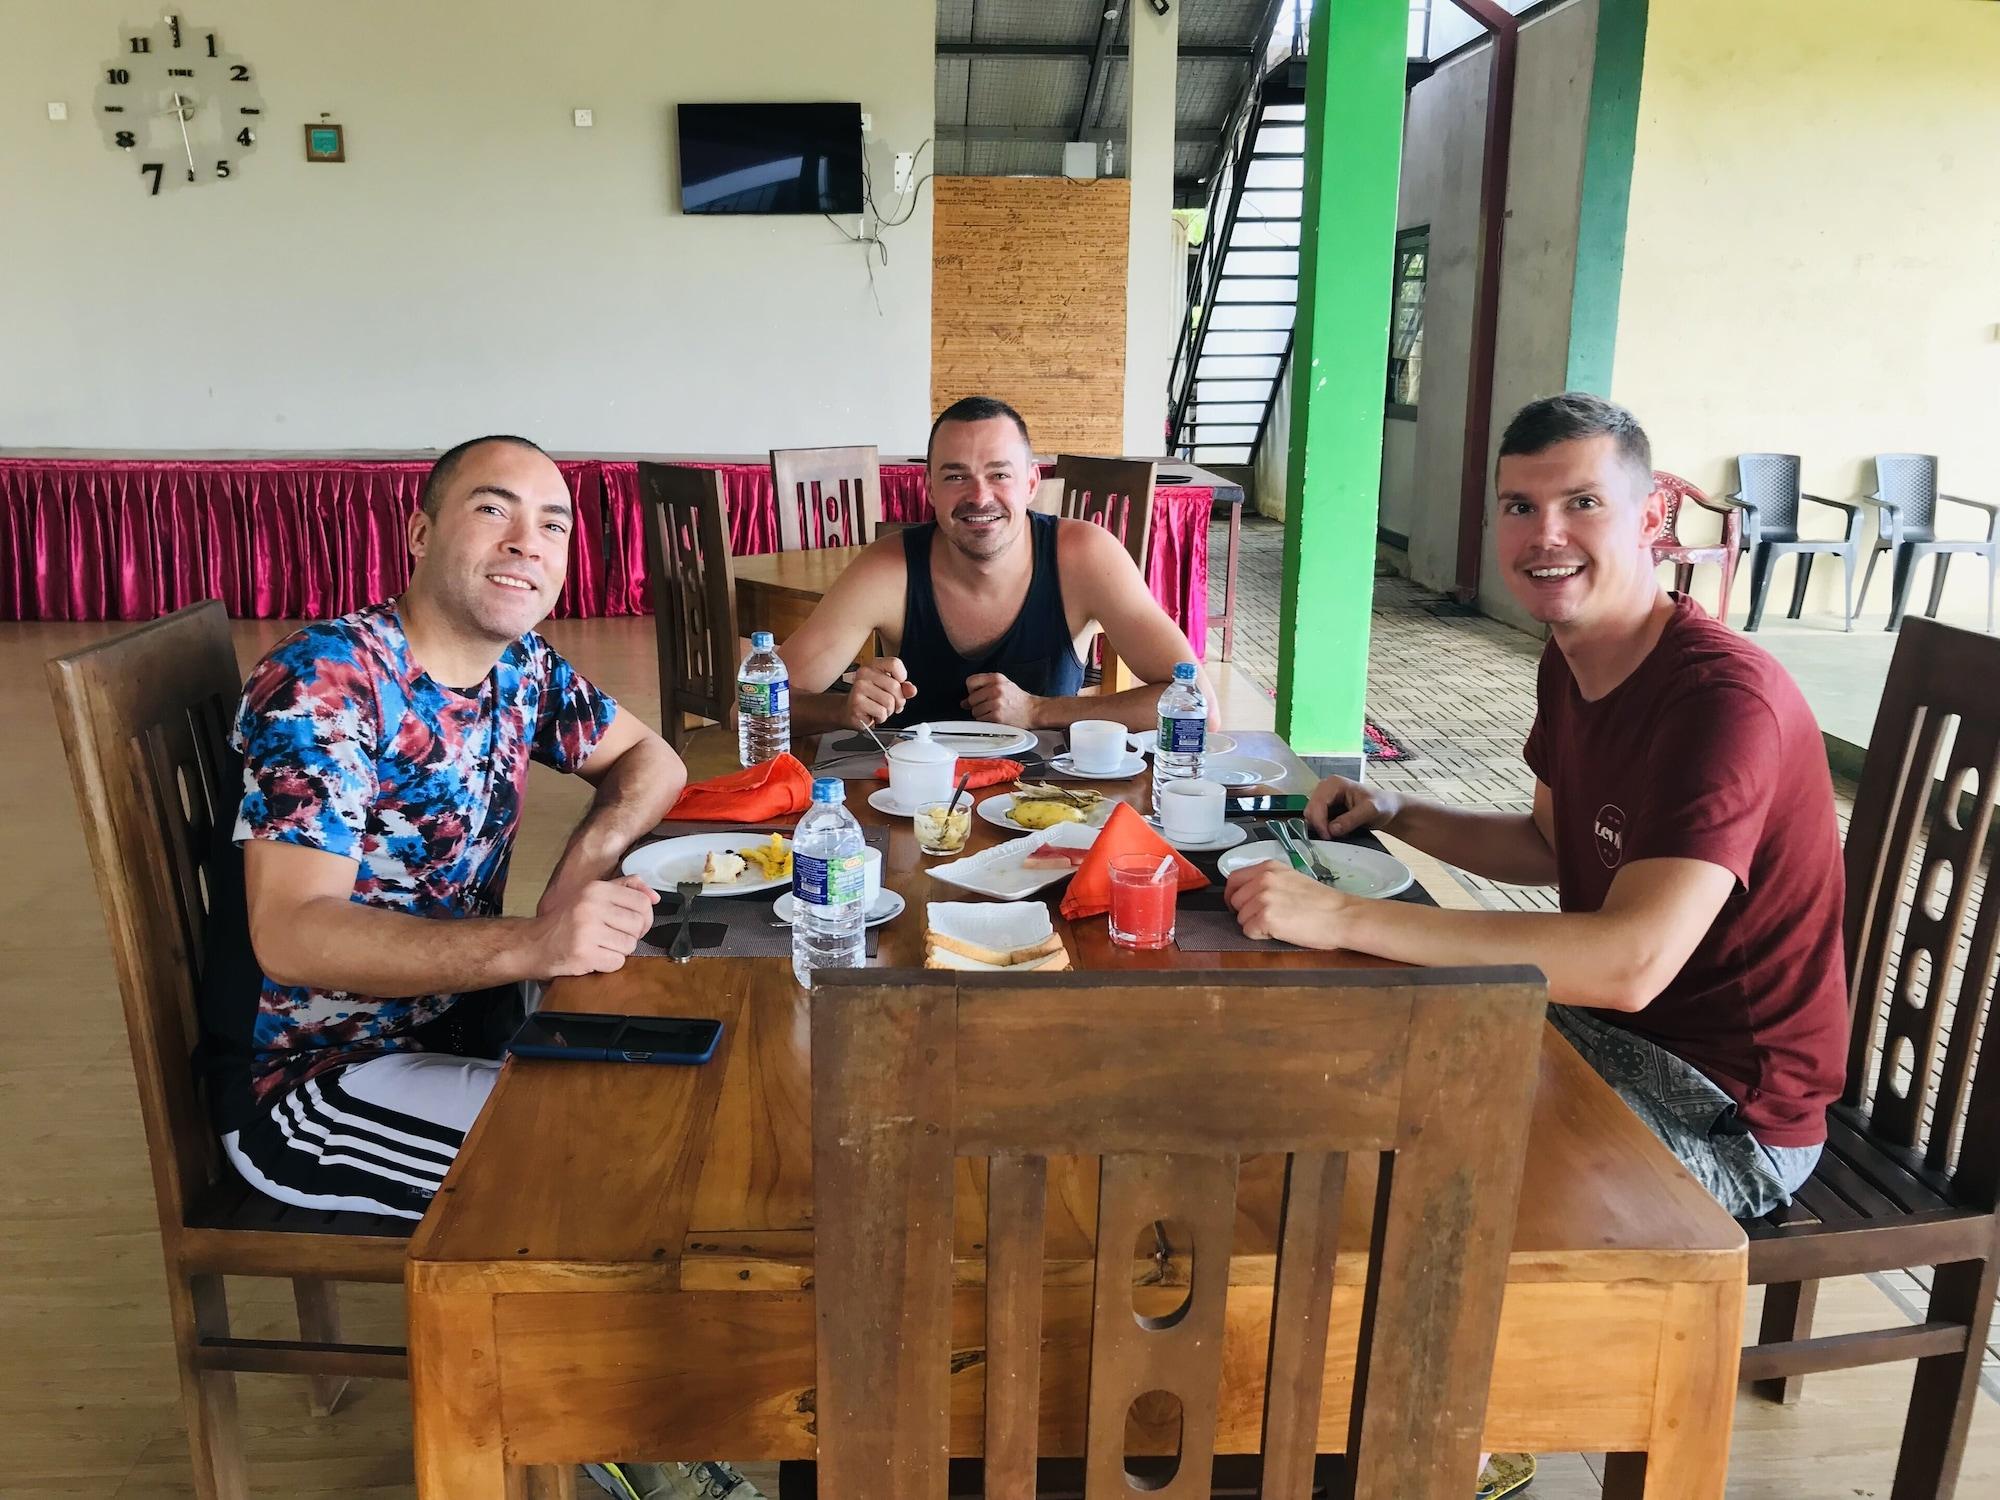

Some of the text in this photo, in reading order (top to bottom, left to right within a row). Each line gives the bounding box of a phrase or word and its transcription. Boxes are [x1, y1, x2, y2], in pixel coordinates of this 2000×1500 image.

[129, 37, 150, 53] 11
[205, 34, 217, 57] 1
[107, 69, 129, 84] 10
[230, 65, 249, 82] 2
[115, 131, 136, 148] 8
[237, 127, 252, 147] 4
[216, 161, 230, 178] 5
[142, 163, 164, 195] 7
